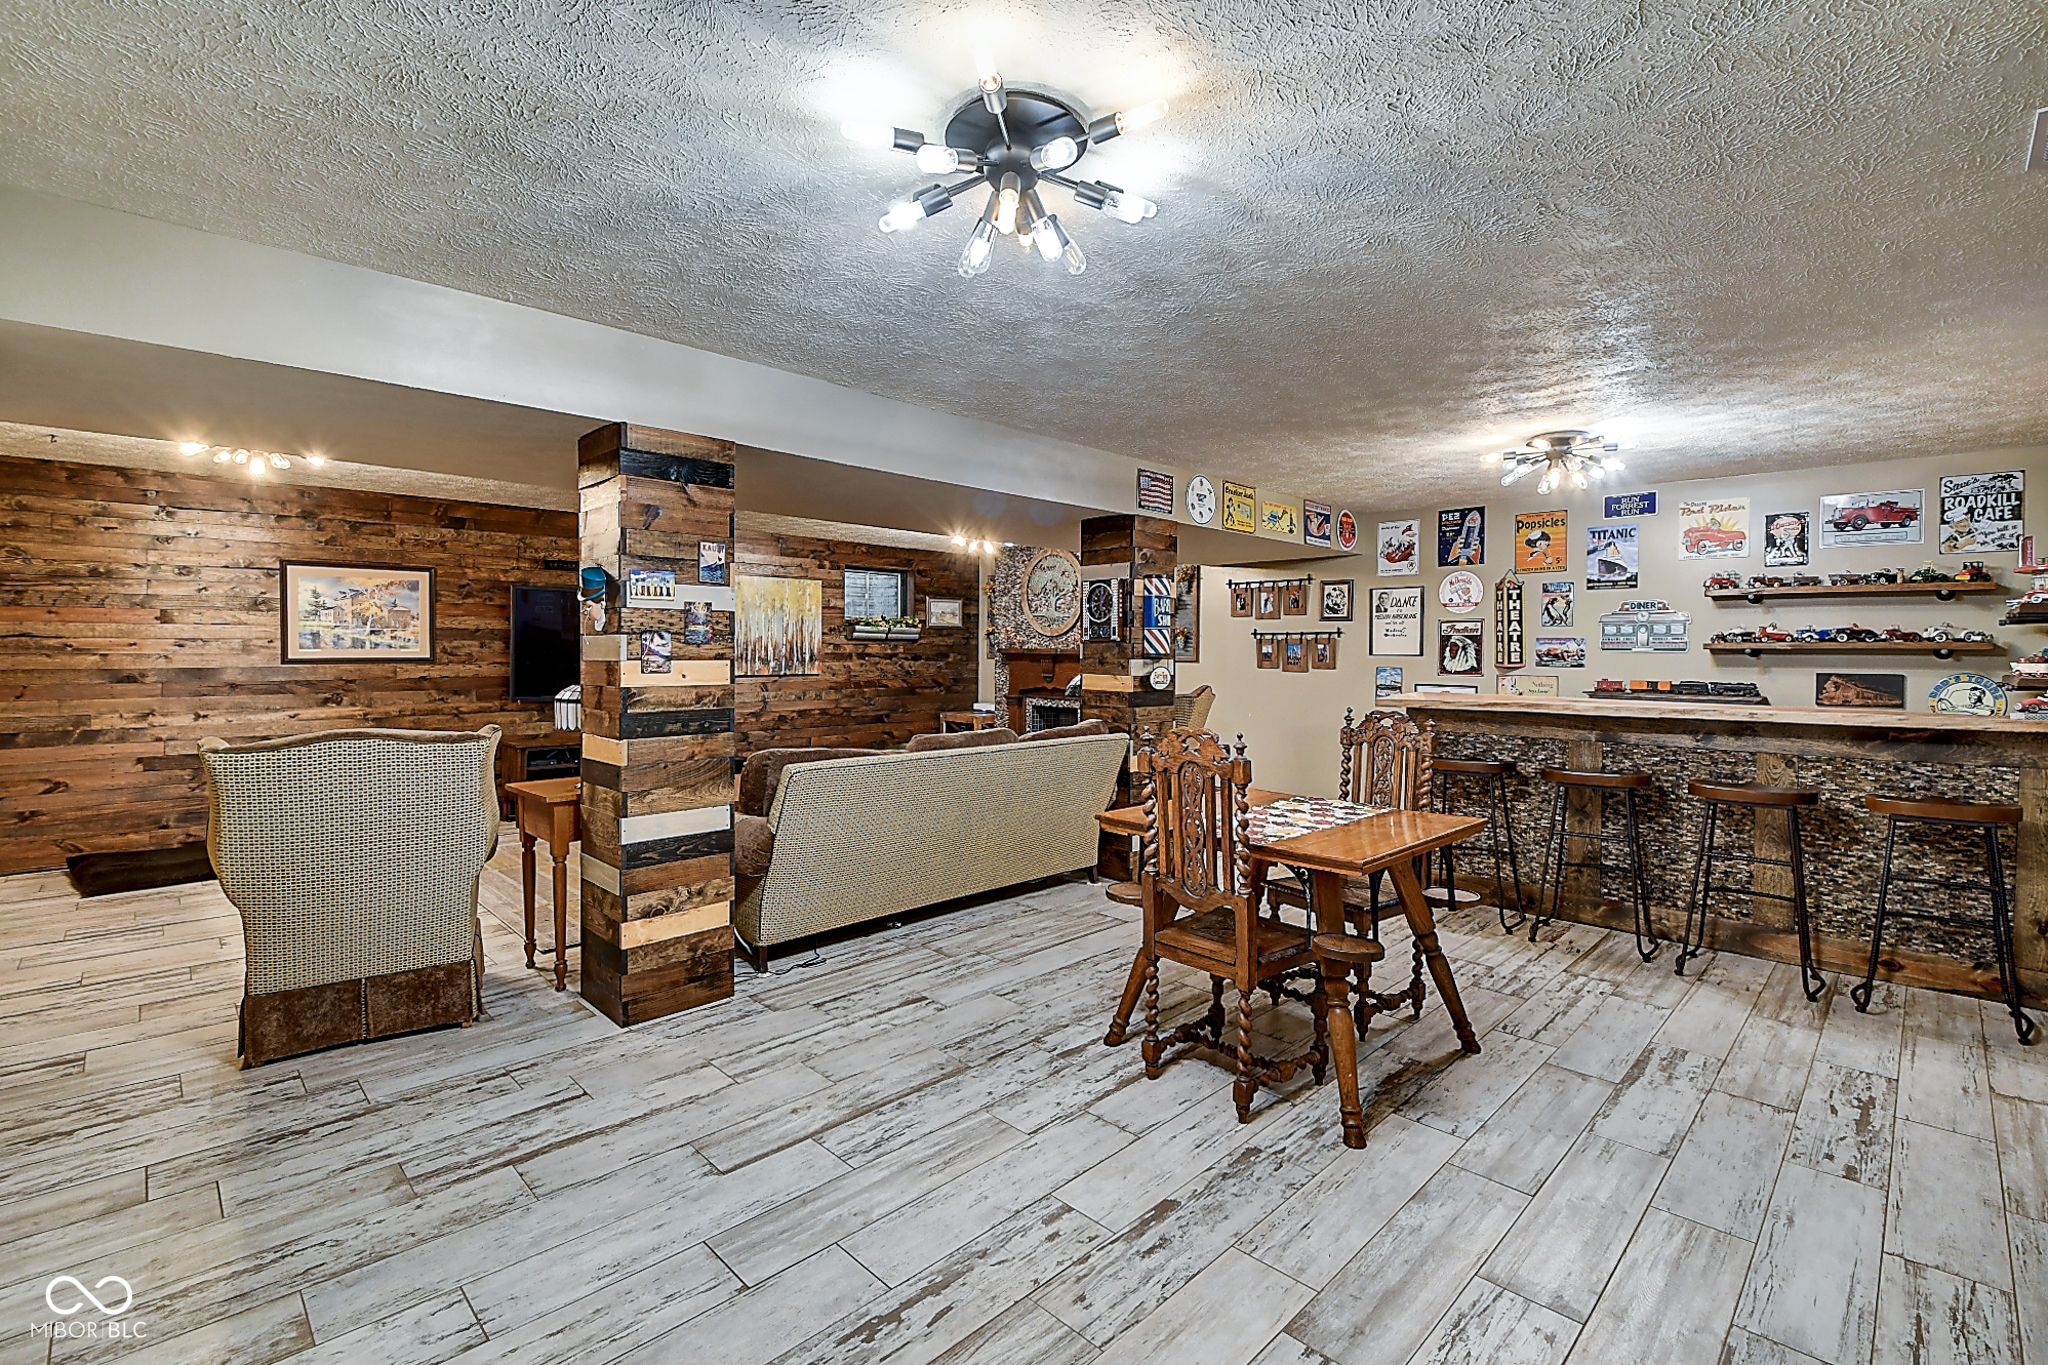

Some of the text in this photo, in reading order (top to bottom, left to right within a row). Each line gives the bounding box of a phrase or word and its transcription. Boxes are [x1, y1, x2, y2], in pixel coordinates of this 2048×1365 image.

[1621, 496, 1640, 504] RUN
[1944, 493, 2020, 511] ROADKILL
[1611, 501, 1650, 511] FORREST
[1441, 512, 1460, 521] PEZ
[1621, 508, 1640, 516] RUN
[1974, 506, 2013, 520] CAFE
[1516, 517, 1566, 534] Popsicles
[1589, 527, 1637, 540] TITANIC
[1389, 595, 1419, 608] DANCE
[1630, 602, 1657, 610] DINER
[1442, 624, 1480, 634] Indian
[1496, 590, 1504, 663] THEATRE
[1508, 589, 1522, 663] THEATRE
[1532, 681, 1554, 689] Nothing
